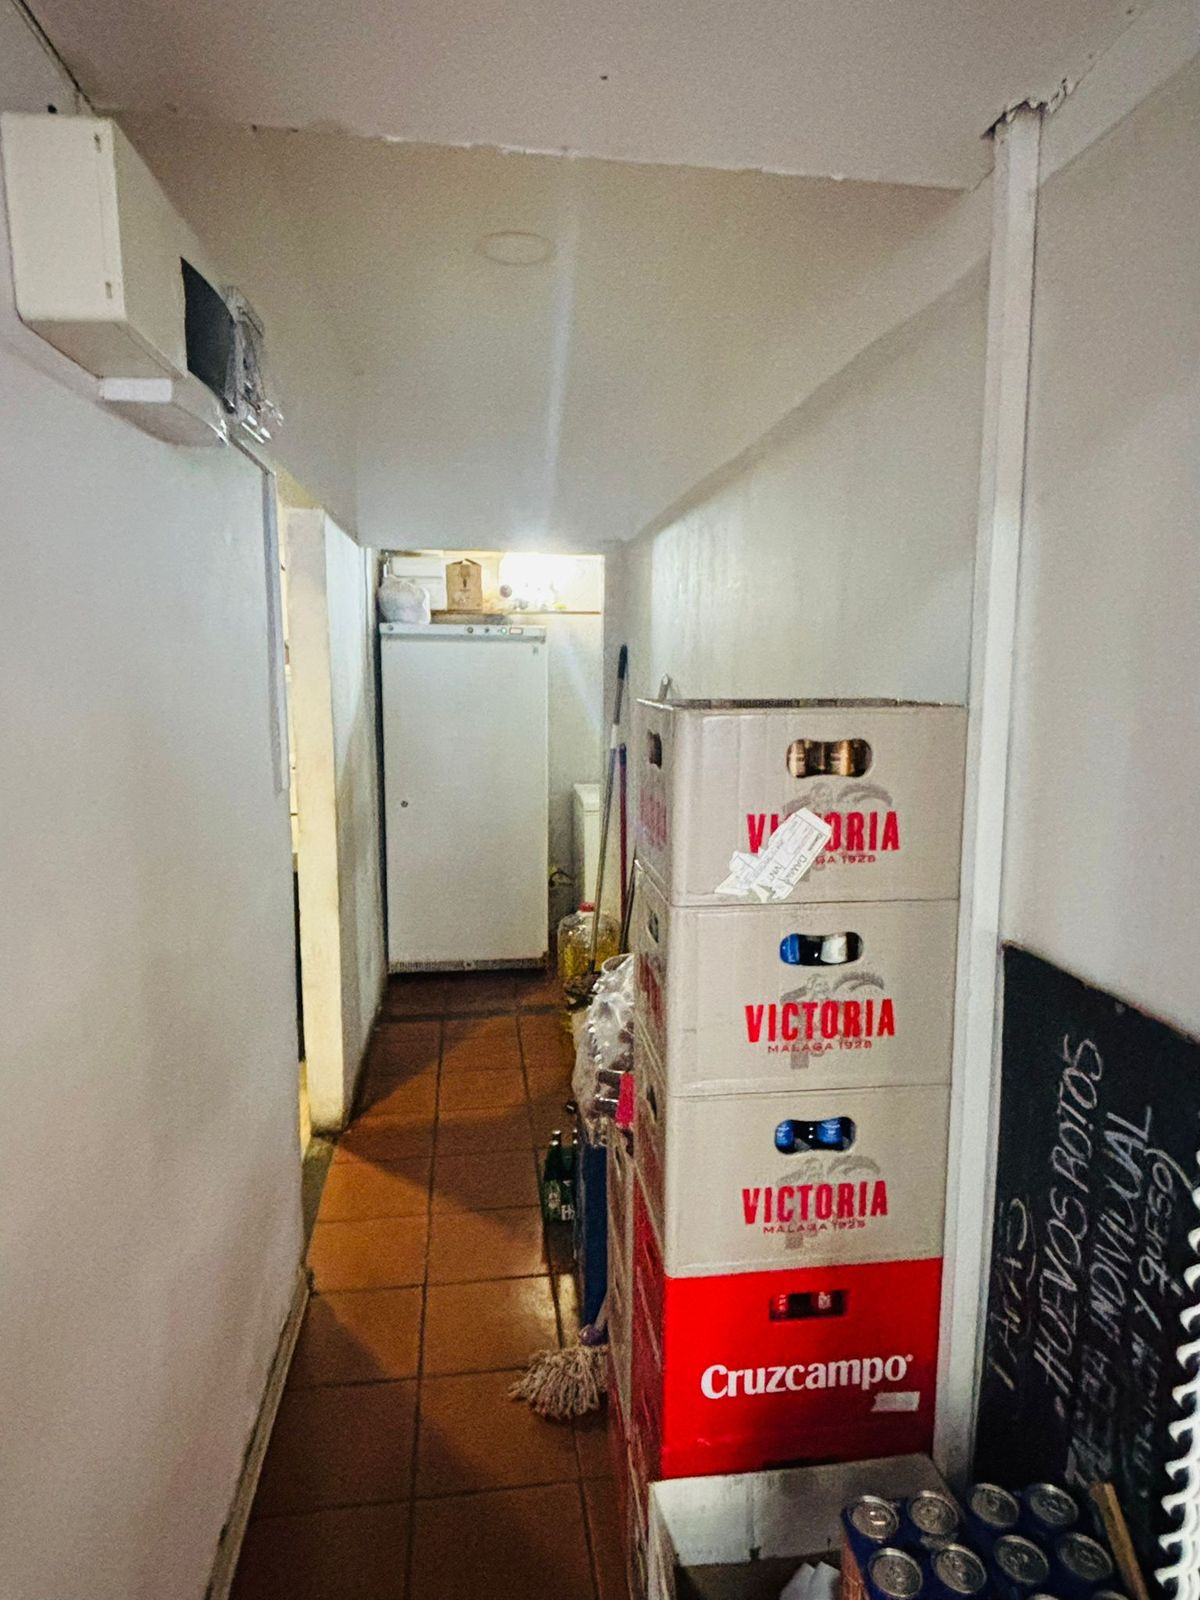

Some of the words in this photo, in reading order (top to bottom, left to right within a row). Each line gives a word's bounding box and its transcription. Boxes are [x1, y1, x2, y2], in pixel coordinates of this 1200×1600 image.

[745, 998, 895, 1043] VICTORIA
[839, 1039, 873, 1049] 1928
[1050, 1033, 1104, 1193] ROTOS
[742, 1180, 888, 1225] VICTORIA
[1033, 1188, 1088, 1396] HUEVOS
[701, 1354, 908, 1400] Cruzcampo
